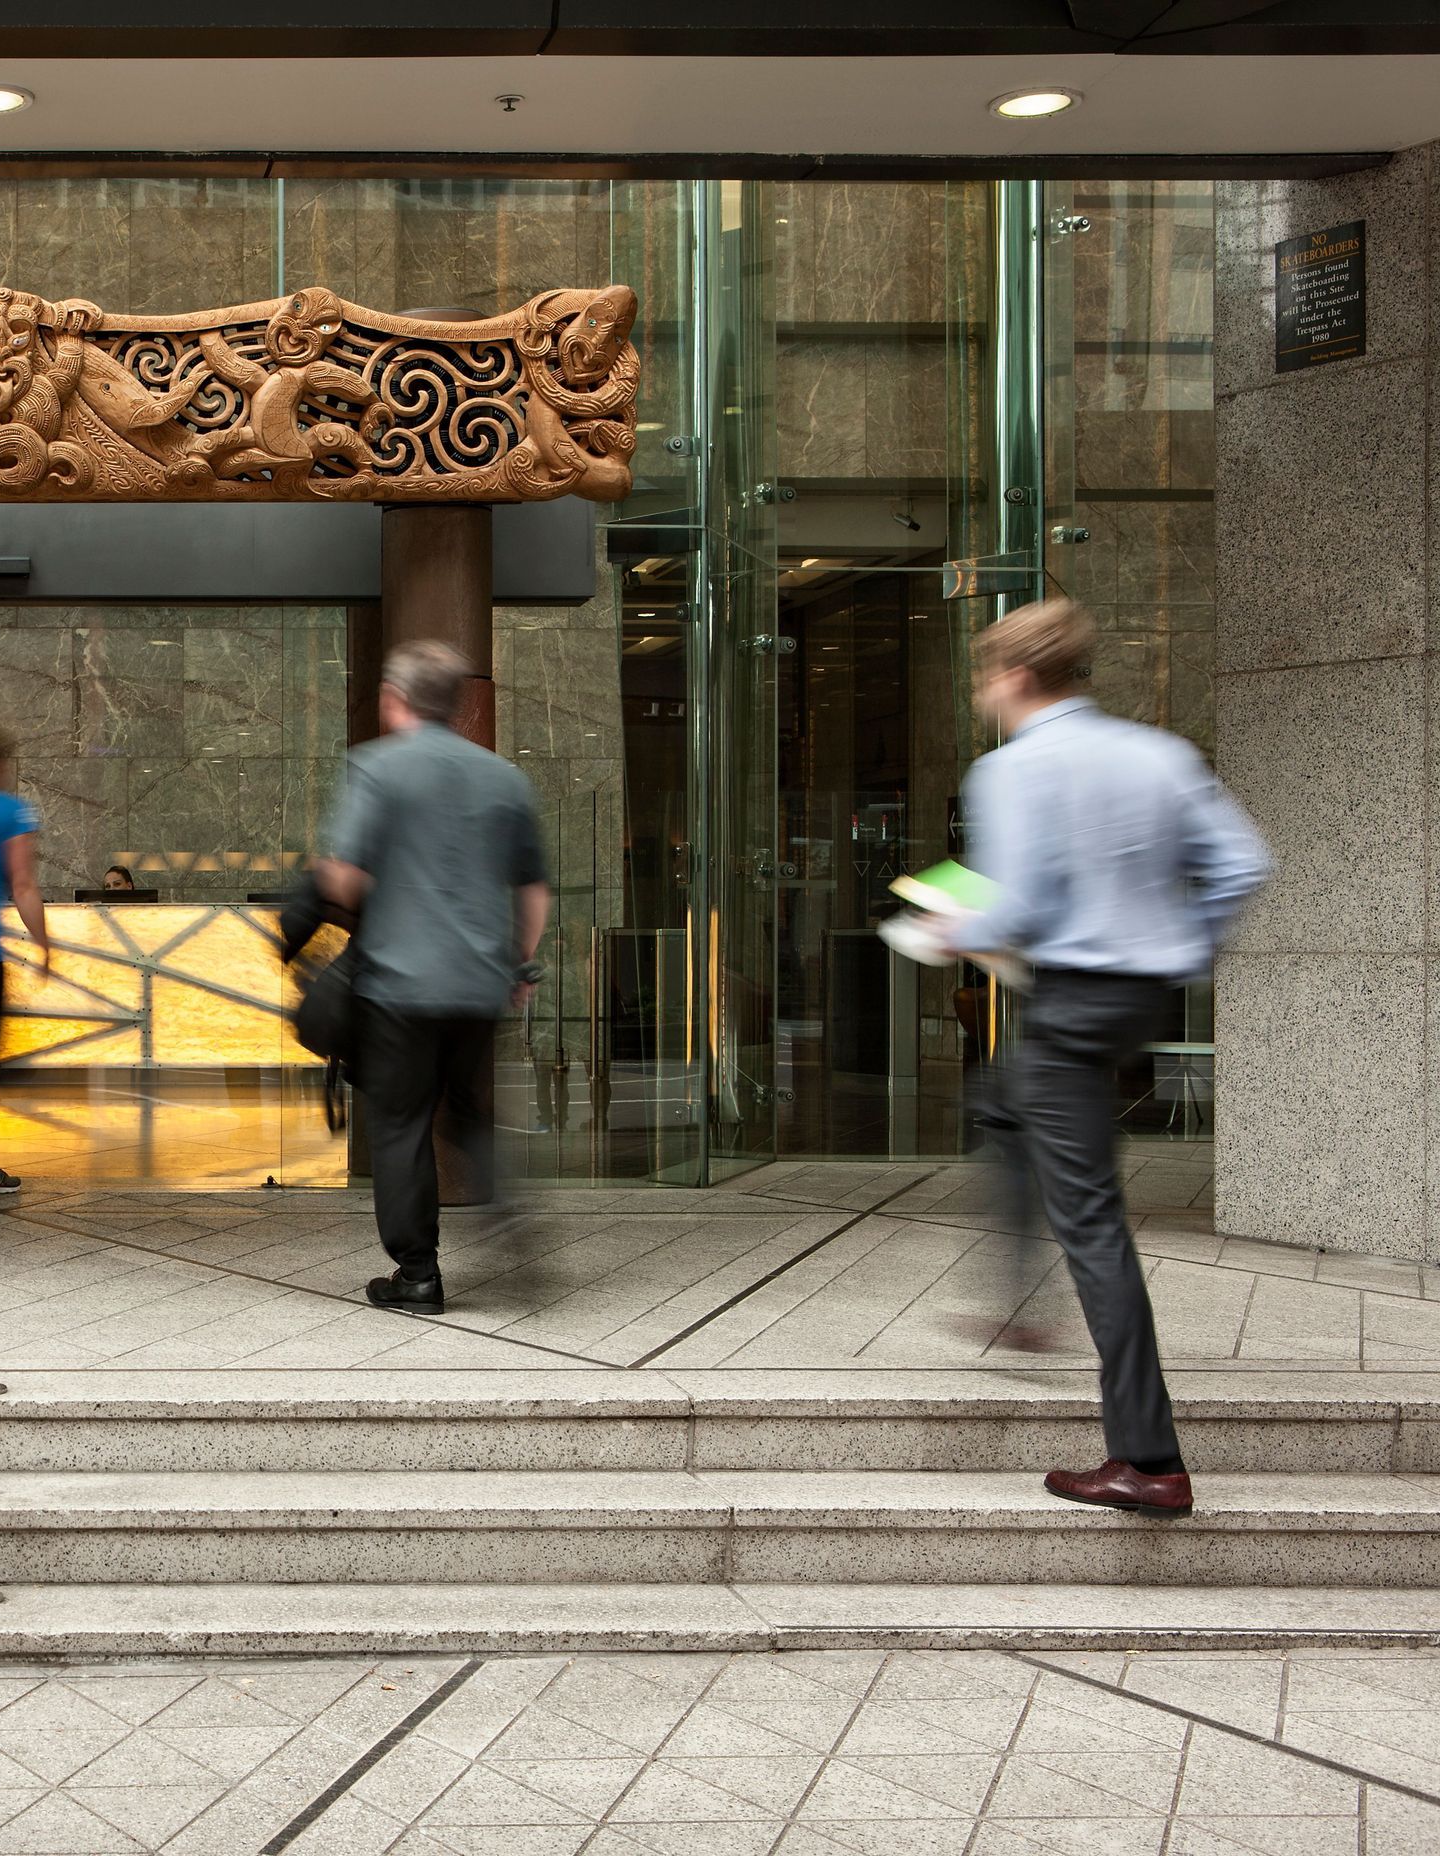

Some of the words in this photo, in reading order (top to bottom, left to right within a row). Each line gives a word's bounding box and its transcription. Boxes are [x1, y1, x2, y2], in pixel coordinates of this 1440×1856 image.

[1311, 233, 1327, 246] NO
[1280, 238, 1360, 268] SKATEBOARDERS
[1291, 268, 1322, 281] Persons
[1324, 259, 1350, 273] found
[1291, 273, 1350, 293] Skateboarding
[1296, 295, 1307, 303] on
[1309, 289, 1327, 299] this
[1329, 284, 1345, 294] Site
[1282, 306, 1299, 317] will
[1301, 304, 1312, 312] be
[1315, 291, 1360, 309] Prosecuted
[1300, 312, 1325, 324] under
[1327, 308, 1342, 318] the
[1296, 323, 1329, 336] Trespass
[1331, 318, 1347, 328] Act
[1311, 332, 1330, 344] 1980
